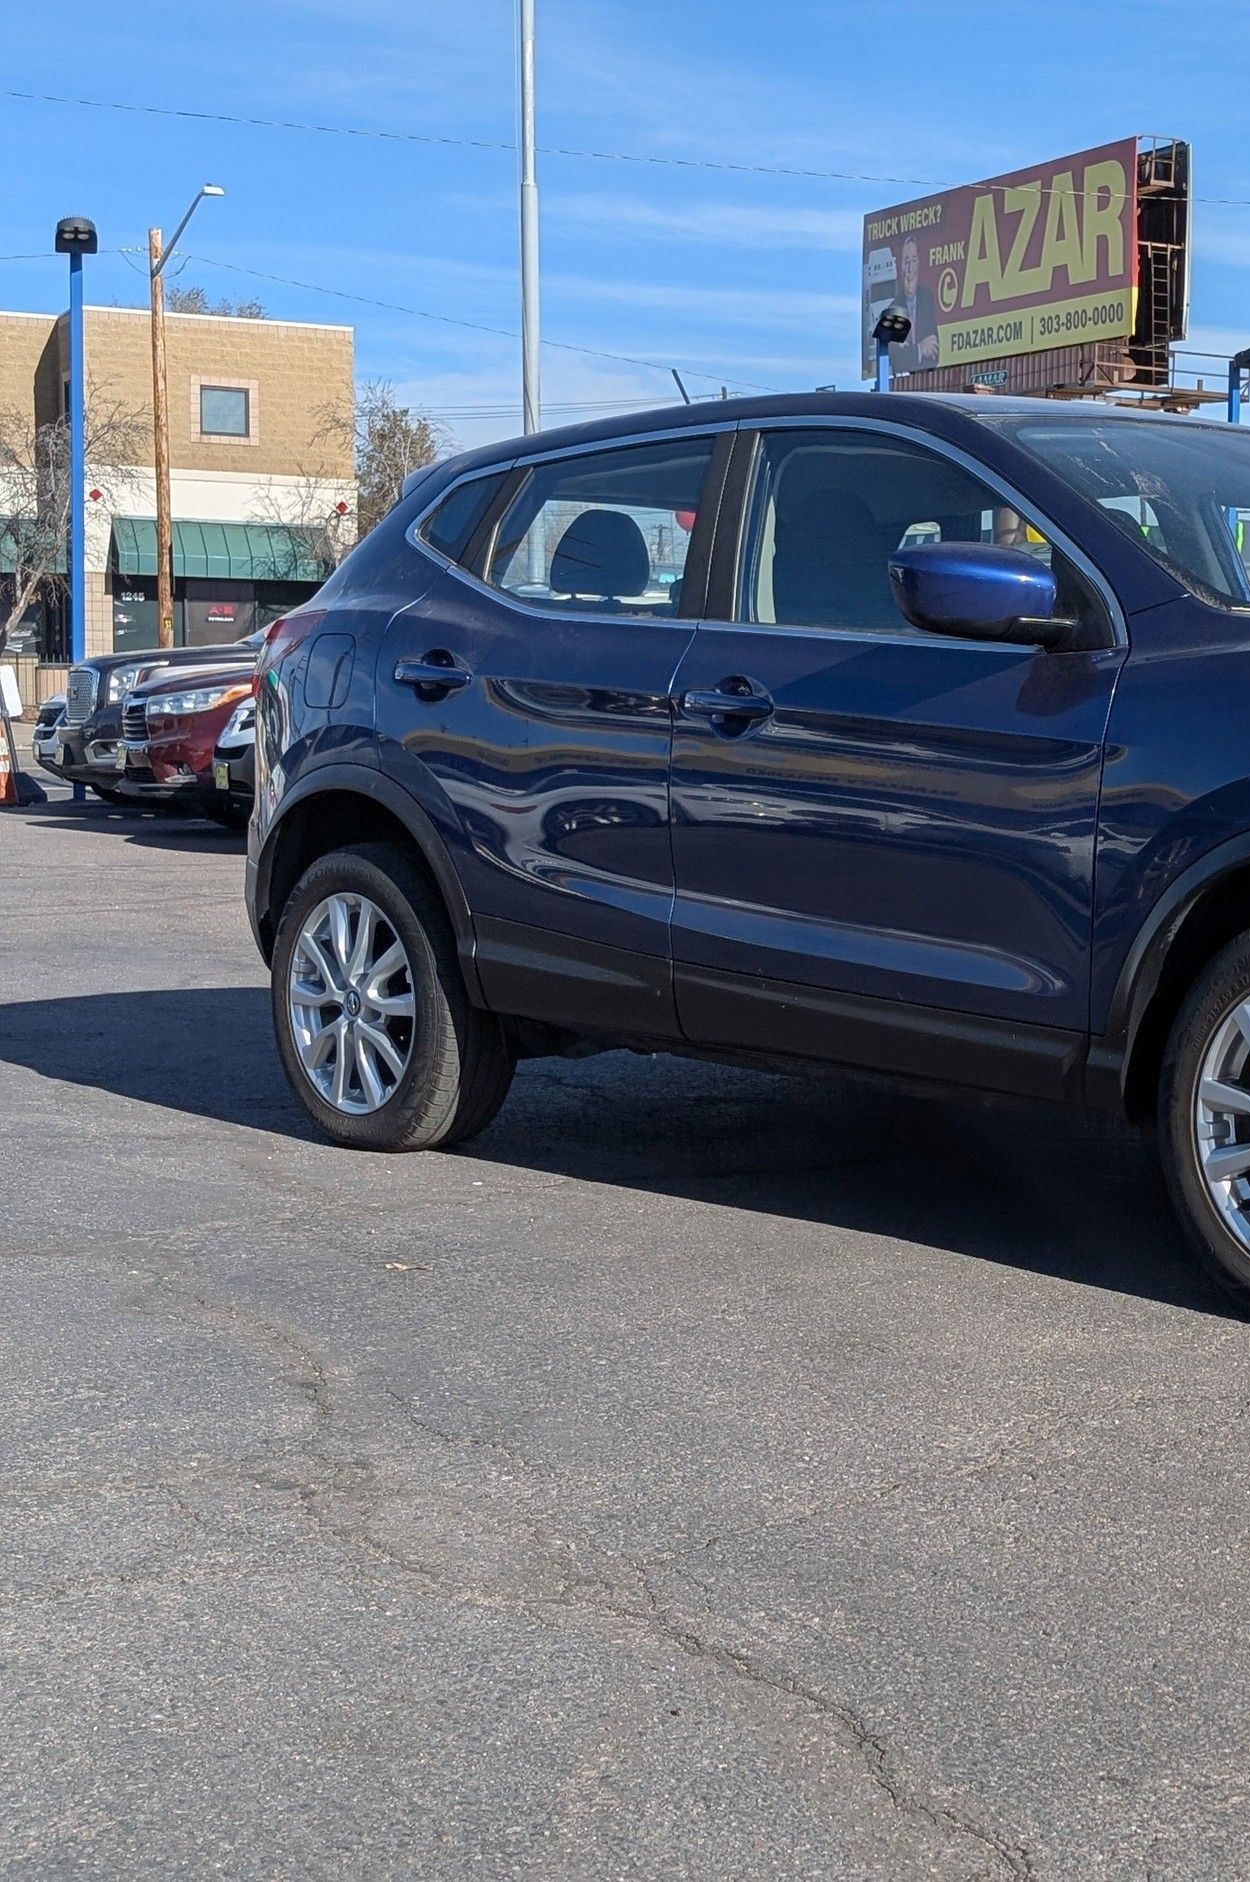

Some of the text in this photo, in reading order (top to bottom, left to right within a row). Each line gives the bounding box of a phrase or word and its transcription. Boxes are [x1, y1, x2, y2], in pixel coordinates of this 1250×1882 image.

[867, 205, 942, 242] TRUCK WRECK?
[961, 160, 1126, 309] AZAR
[929, 241, 966, 267] FRANK
[950, 321, 1023, 353] FDAZAR.COM
[1039, 302, 1124, 337] 303-800-0000
